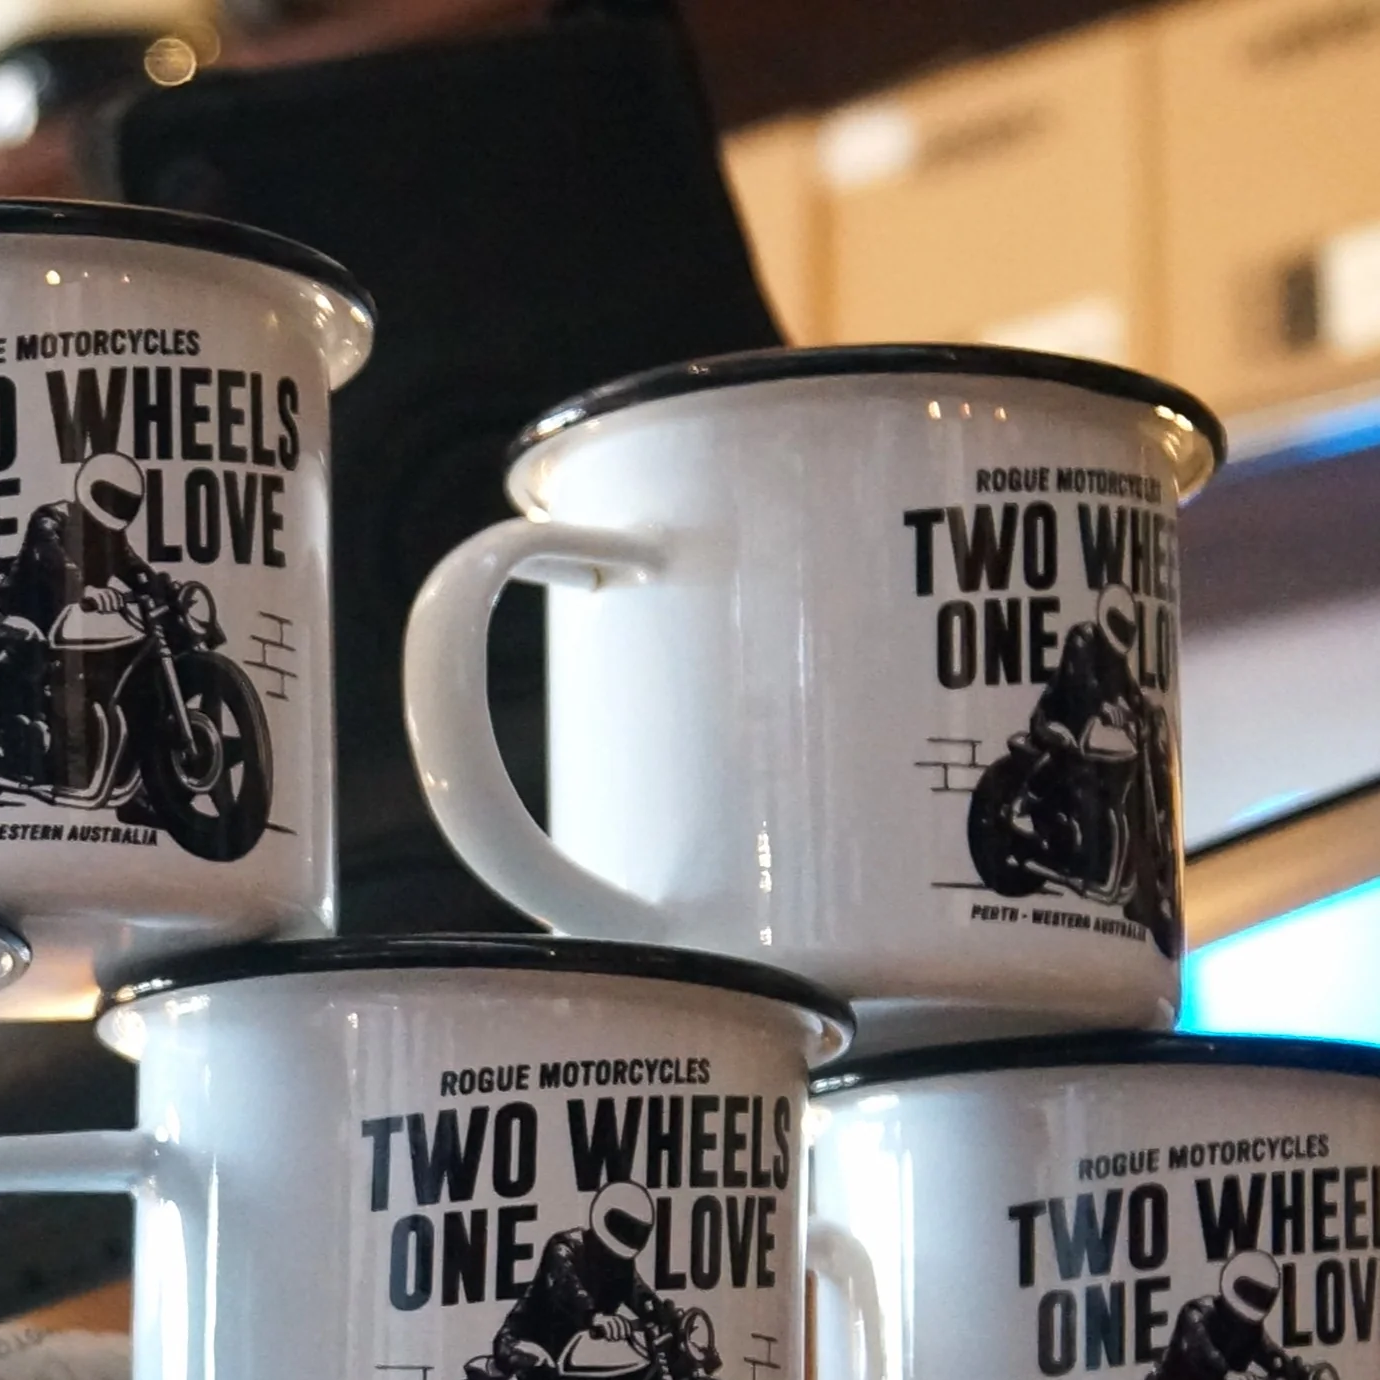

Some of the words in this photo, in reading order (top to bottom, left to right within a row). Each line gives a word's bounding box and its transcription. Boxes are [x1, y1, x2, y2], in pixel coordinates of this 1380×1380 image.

[16, 328, 200, 361] MOTORCYCLES
[46, 366, 300, 471] WHEELS
[146, 467, 286, 568] LOVE
[976, 467, 1050, 493] ROGUE
[903, 500, 1058, 597] TWO
[937, 596, 1061, 690] ONE
[67, 825, 158, 845] AUSTRALIA
[440, 1064, 530, 1097] ROGUE
[539, 1057, 711, 1090] MOTORCYCLES
[361, 1100, 538, 1212] TWO
[567, 1095, 790, 1192] WHEELS
[1078, 1149, 1160, 1180] ROGUE
[1168, 1133, 1329, 1169] MOTORCYCLES
[389, 1204, 538, 1311] ONE
[654, 1194, 776, 1290] LOVE
[1008, 1182, 1168, 1288] TWO
[1038, 1275, 1171, 1377] ONE
